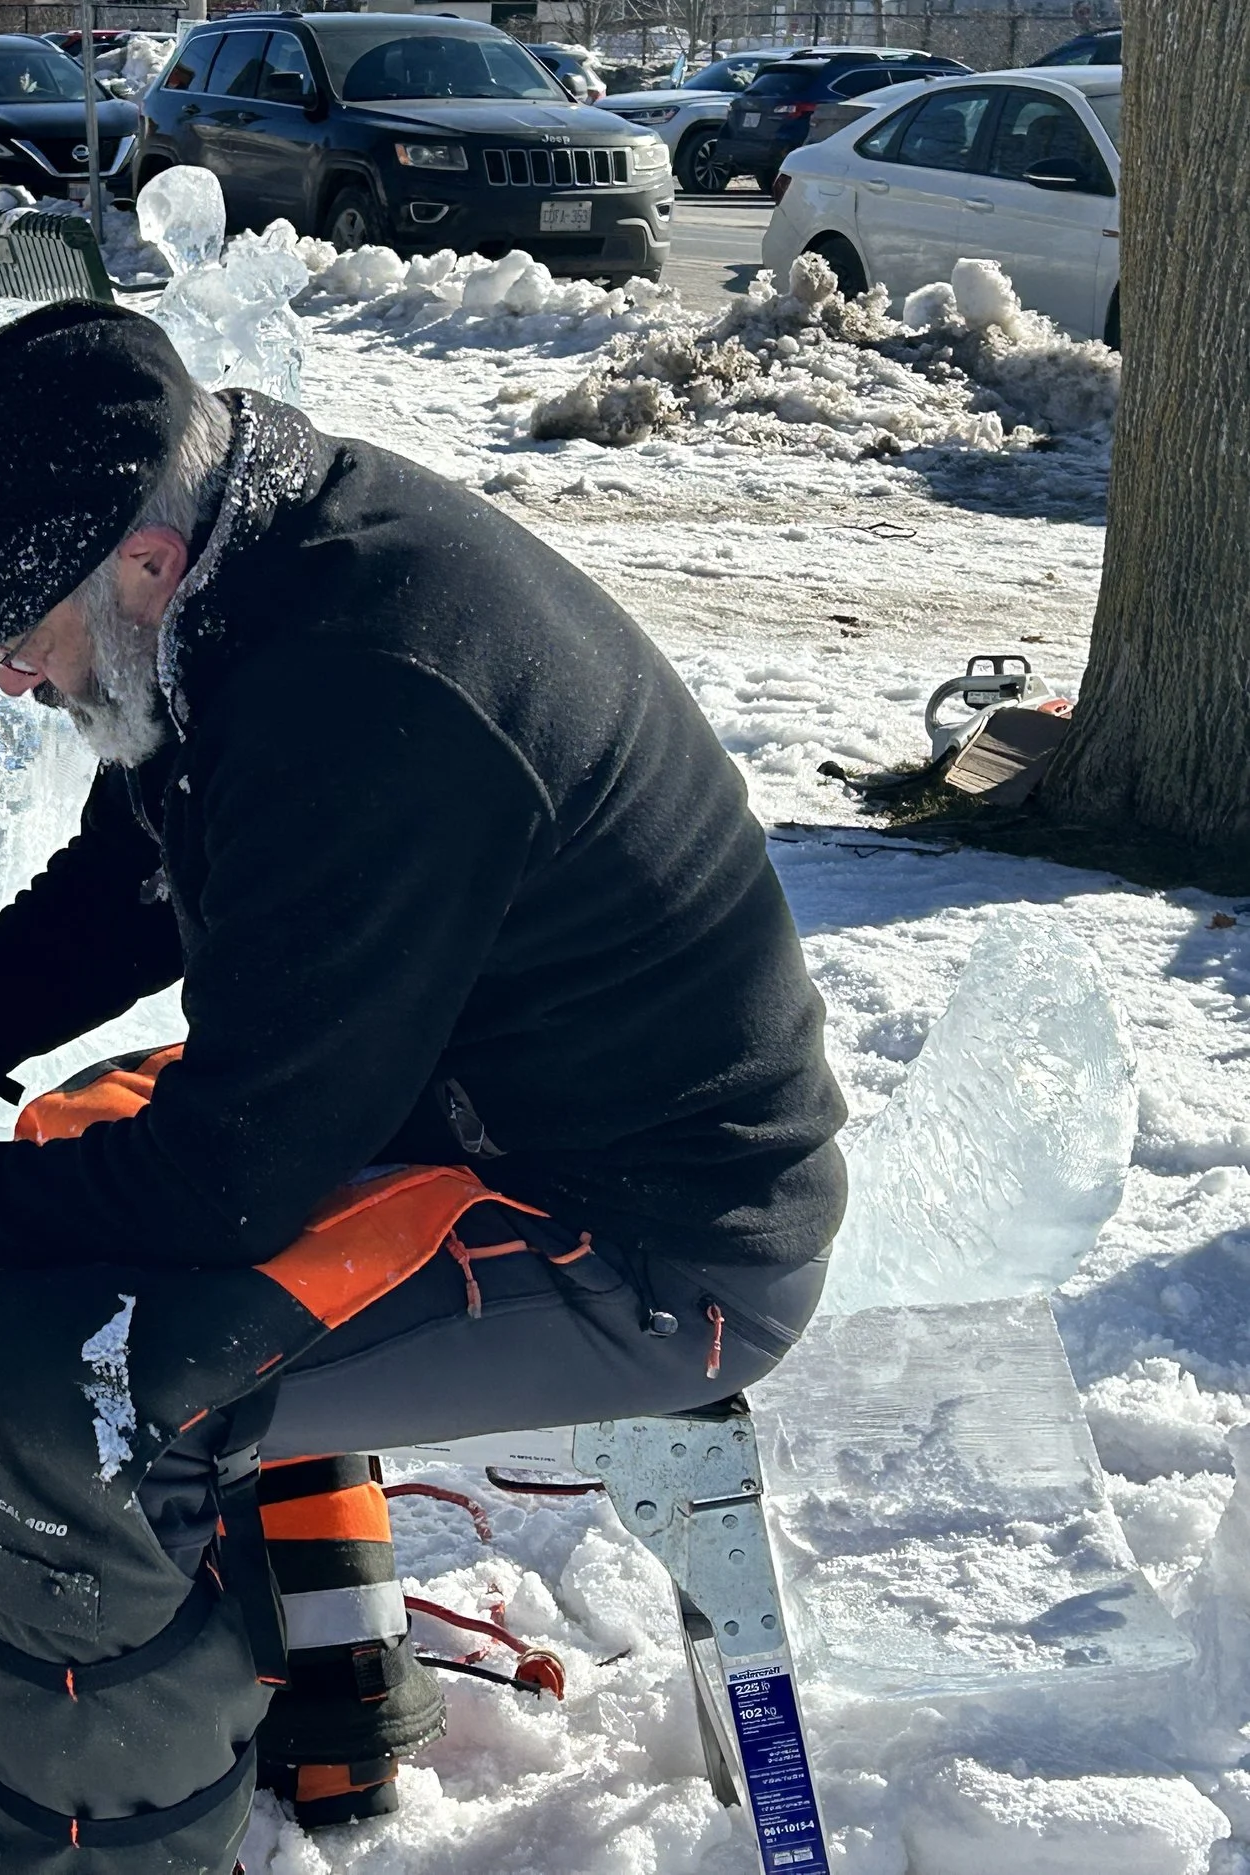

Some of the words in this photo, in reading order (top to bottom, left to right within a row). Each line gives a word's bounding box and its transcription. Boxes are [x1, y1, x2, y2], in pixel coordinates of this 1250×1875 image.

[541, 134, 570, 144] Jeep
[25, 1518, 68, 1537] 4000
[735, 1682, 760, 1695] 225
[740, 1707, 763, 1720] 102
